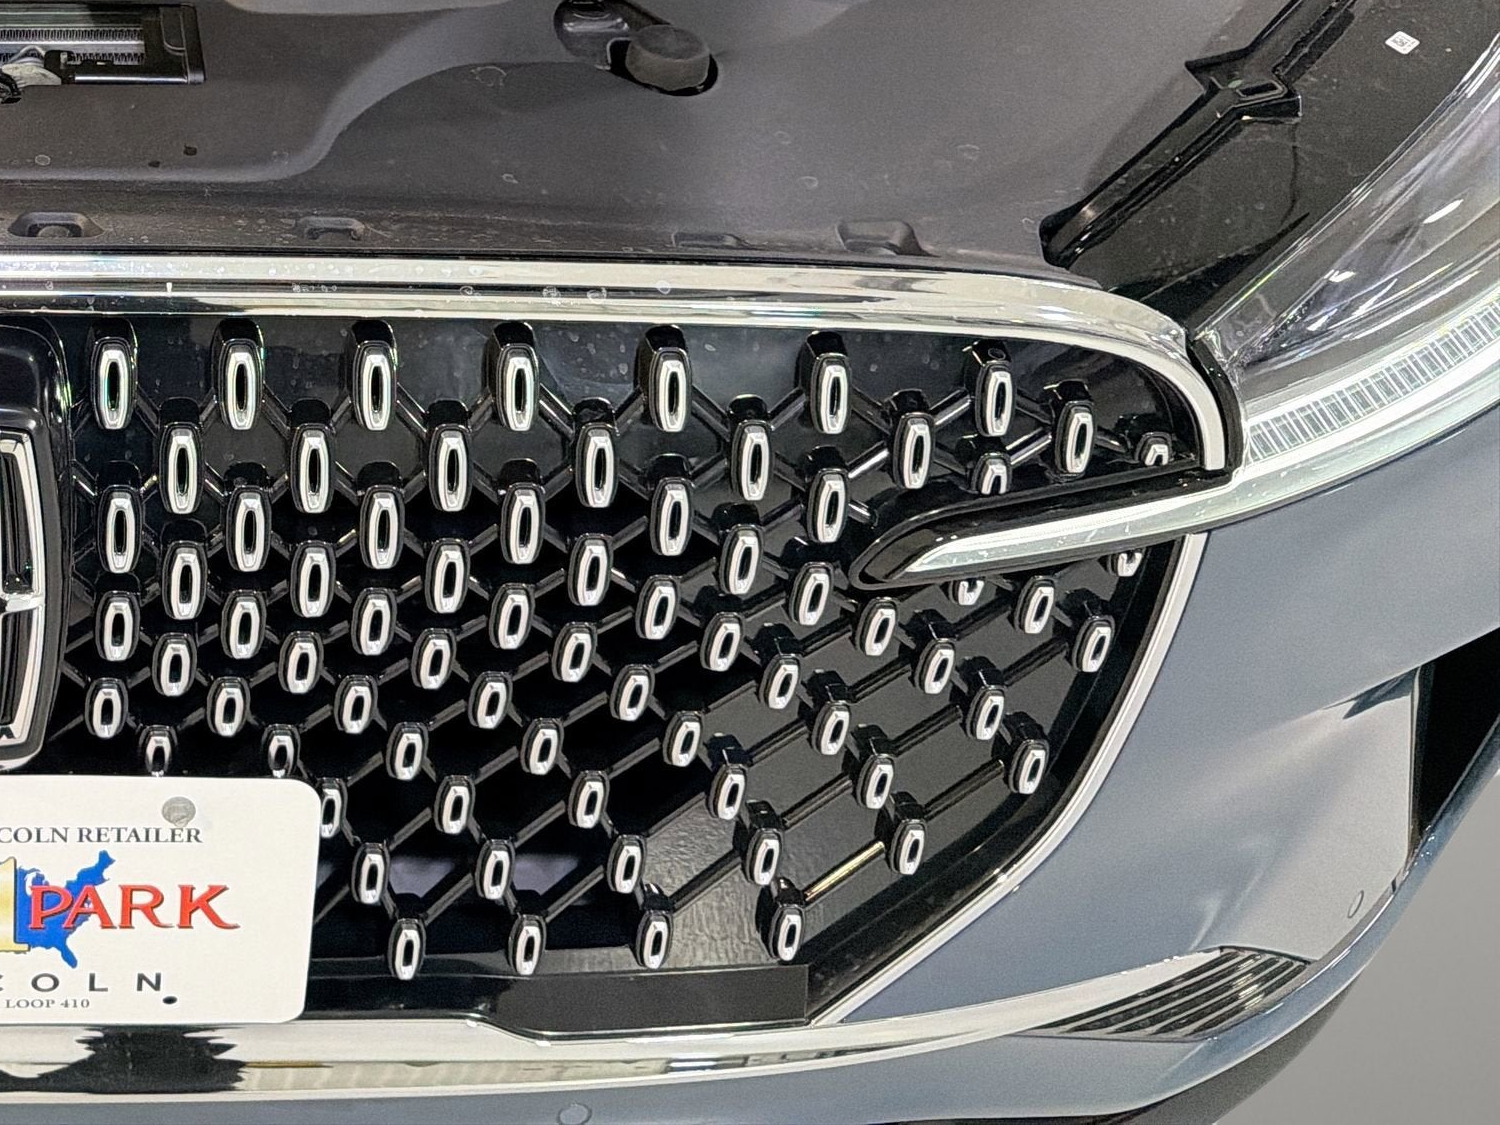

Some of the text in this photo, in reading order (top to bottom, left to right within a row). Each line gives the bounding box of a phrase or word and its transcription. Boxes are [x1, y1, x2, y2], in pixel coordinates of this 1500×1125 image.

[76, 826, 203, 843] RETAILER
[29, 884, 241, 930] PARK
[5, 999, 55, 1009] LOOP
[60, 999, 90, 1009] 410
